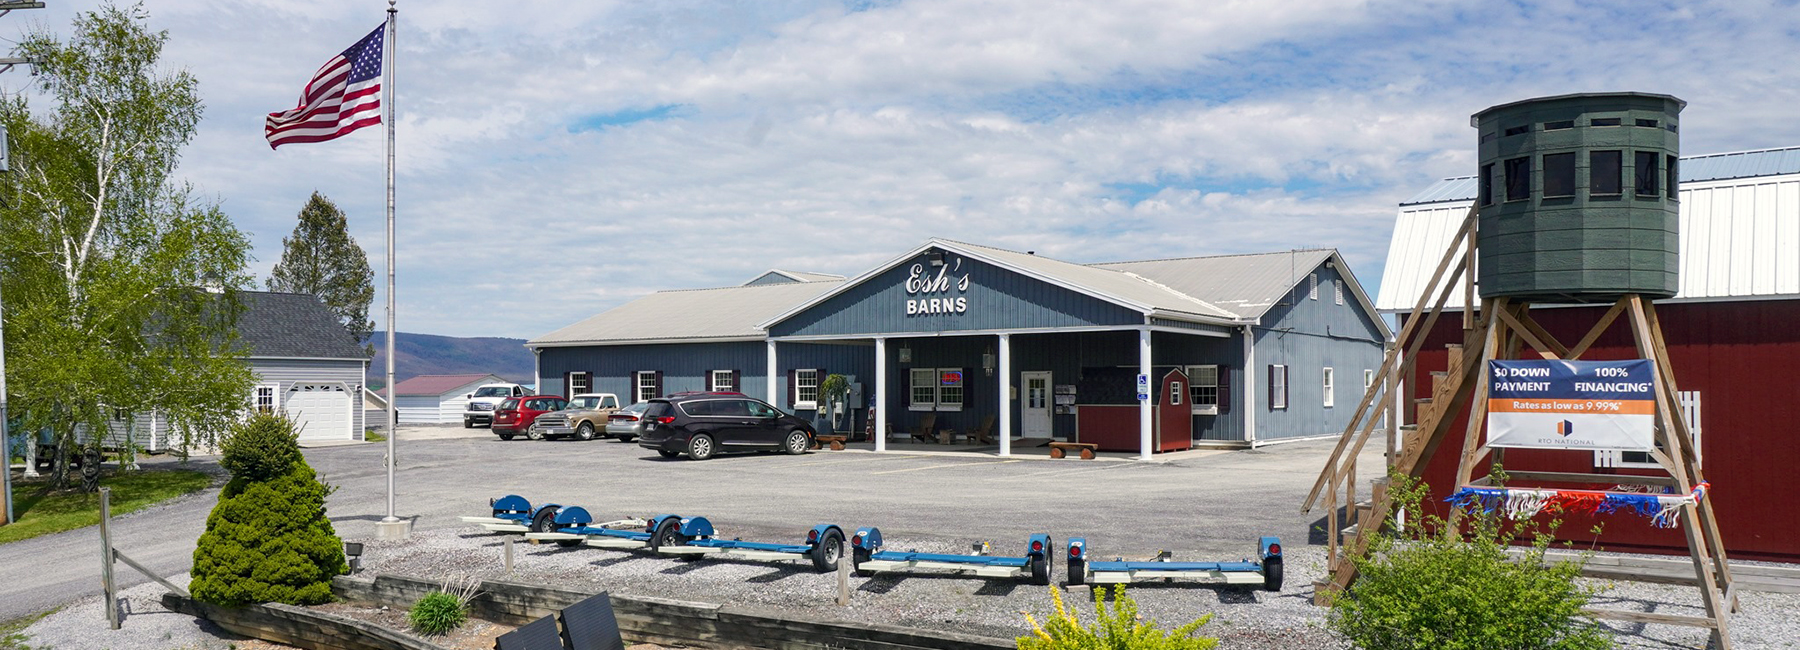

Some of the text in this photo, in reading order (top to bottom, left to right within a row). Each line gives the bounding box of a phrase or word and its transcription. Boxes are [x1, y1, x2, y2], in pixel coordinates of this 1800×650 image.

[905, 257, 970, 294] Esh's
[906, 297, 967, 315] BARNS
[1494, 367, 1550, 378] $0 DOWN
[1594, 367, 1629, 378] 100%
[1494, 382, 1551, 392] PAYMENT
[1513, 401, 1540, 410] Rates
[1541, 402, 1552, 410] as
[1553, 401, 1572, 410] low
[1573, 403, 1584, 411] as
[1554, 438, 1595, 446] NATIONAL
